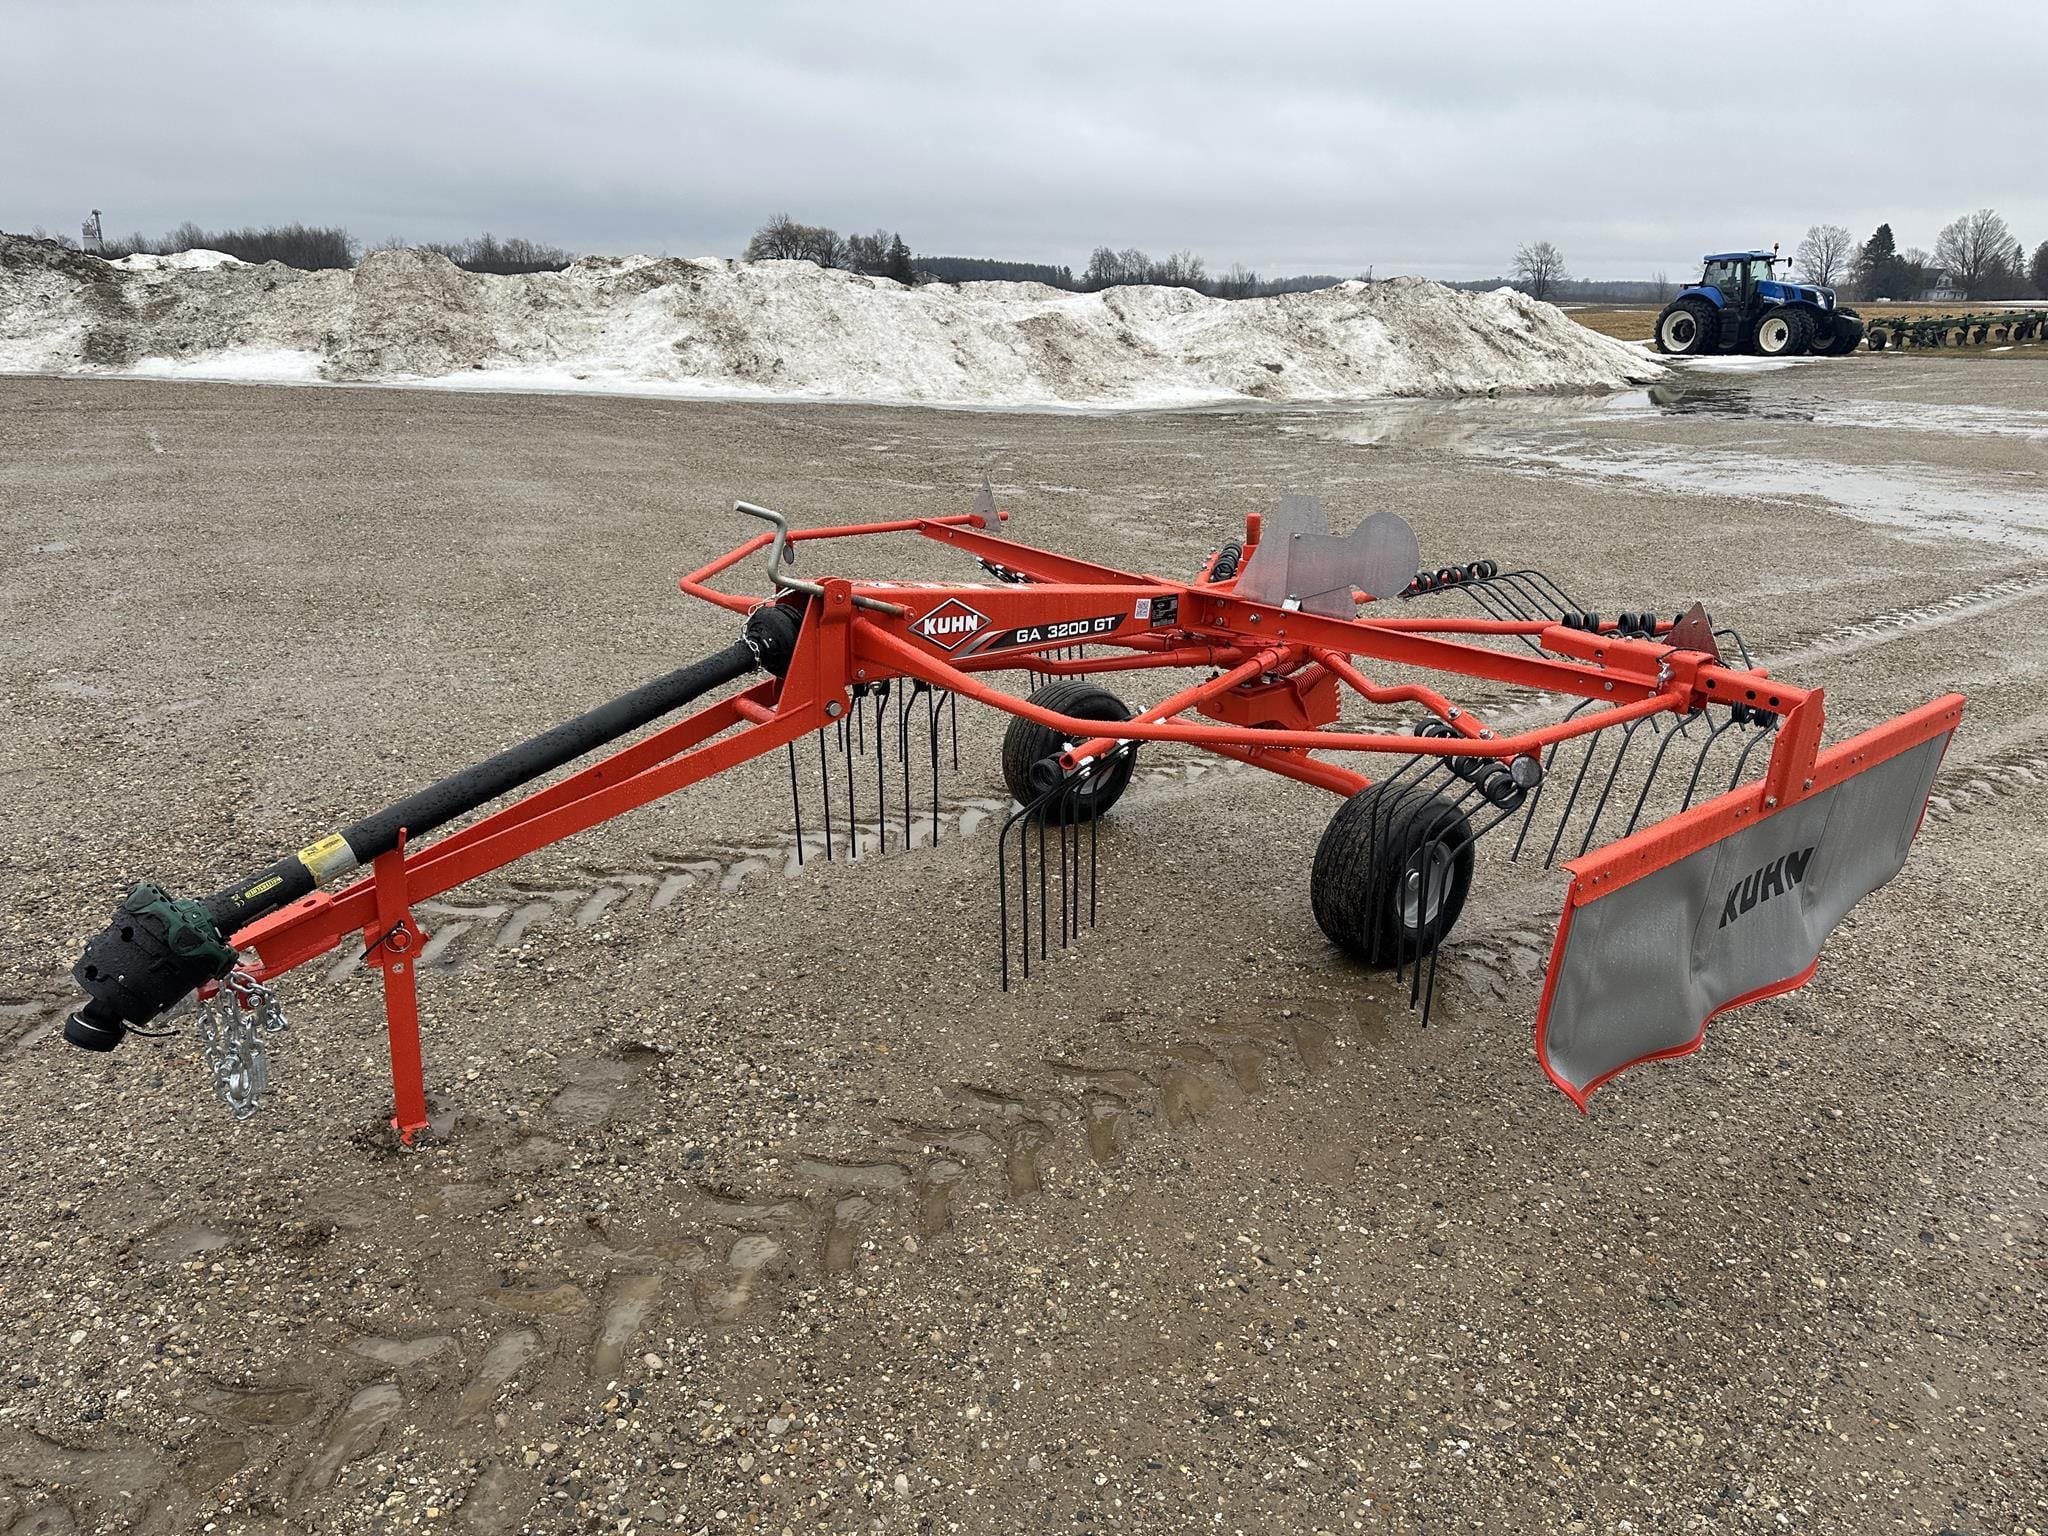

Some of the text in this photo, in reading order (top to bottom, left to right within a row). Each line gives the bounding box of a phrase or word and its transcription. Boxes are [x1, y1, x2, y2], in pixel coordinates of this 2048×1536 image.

[923, 614, 978, 635] KUHN
[1016, 616, 1116, 643] GA 3200 GT
[1718, 846, 1815, 930] KUHN
